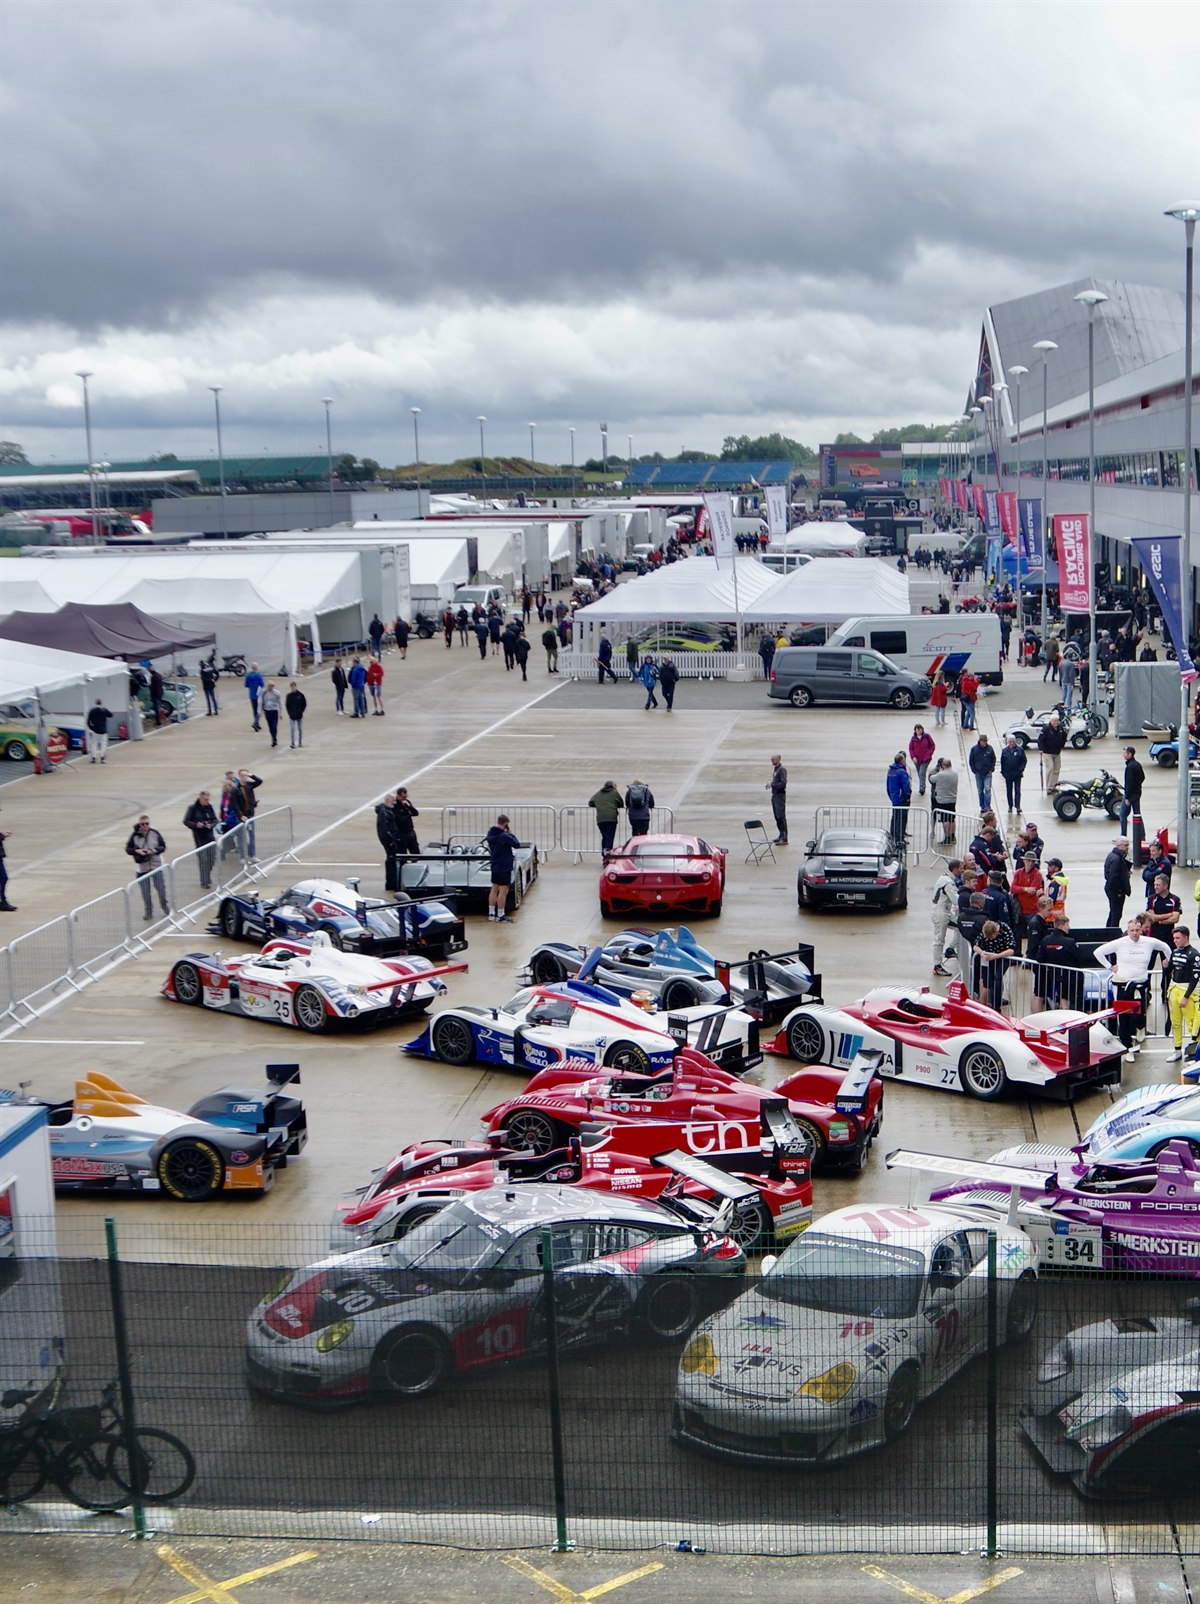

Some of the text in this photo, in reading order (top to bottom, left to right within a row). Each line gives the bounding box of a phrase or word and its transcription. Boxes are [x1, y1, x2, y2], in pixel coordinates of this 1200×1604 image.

[274, 1000, 290, 1018] 25
[916, 1064, 931, 1074] P900
[940, 1068, 957, 1085] 27
[610, 1177, 642, 1186] NISSAN
[842, 1206, 932, 1241] 70
[1064, 1238, 1095, 1263] 34
[337, 1290, 376, 1313] 10
[838, 1321, 875, 1338] 70
[878, 1326, 908, 1350] PVS
[476, 1324, 515, 1356] 10
[764, 1358, 802, 1376] PVS
